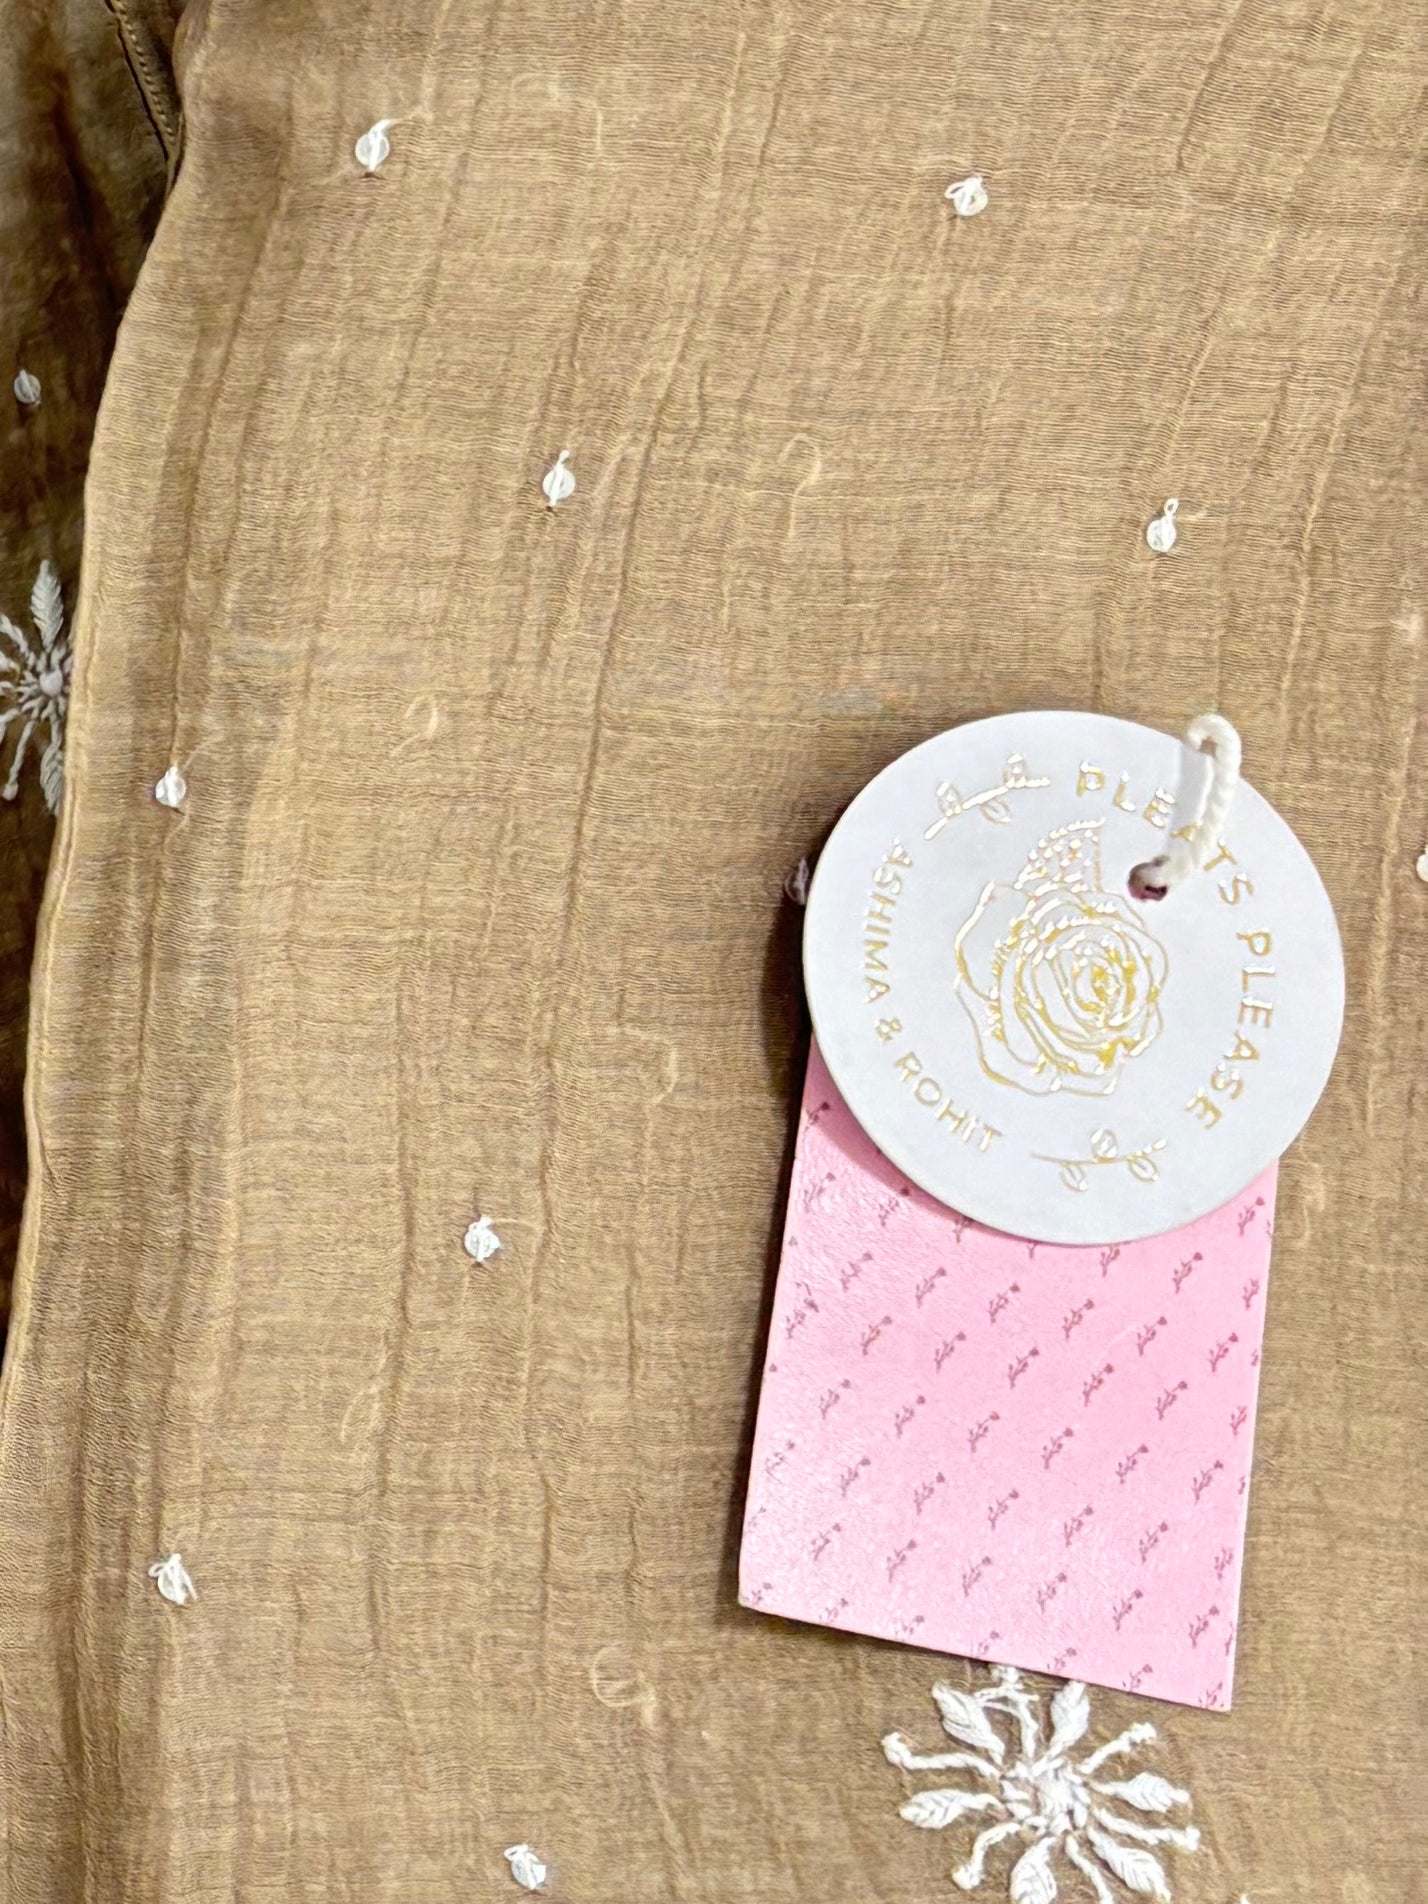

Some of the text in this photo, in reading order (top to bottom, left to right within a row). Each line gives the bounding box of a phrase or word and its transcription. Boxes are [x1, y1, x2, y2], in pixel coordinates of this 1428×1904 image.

[862, 838, 1003, 1153] ASHIMA & ROHIT
[1184, 929, 1276, 1131] PLEASE
